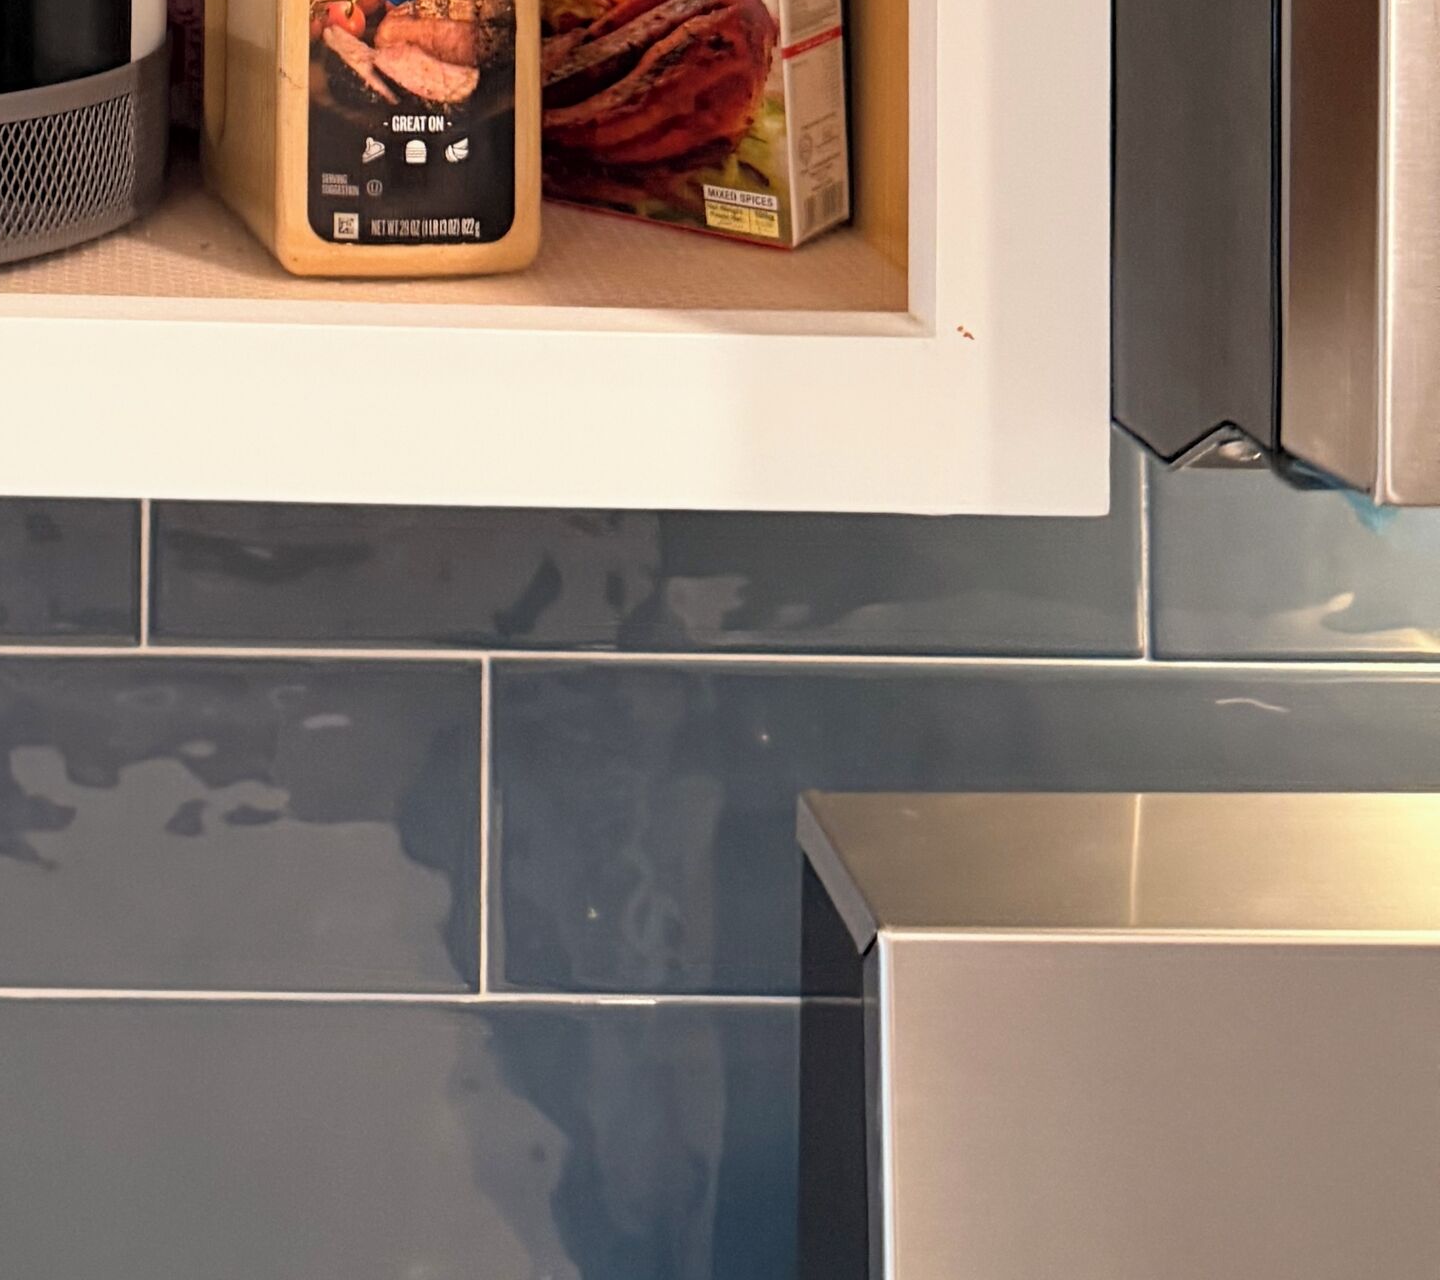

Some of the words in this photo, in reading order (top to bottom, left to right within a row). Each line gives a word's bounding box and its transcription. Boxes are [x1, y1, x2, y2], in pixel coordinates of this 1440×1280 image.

[392, 116, 427, 131] GREAT
[429, 116, 444, 132] ON
[708, 188, 736, 201] MIXED
[740, 193, 773, 207] SPICES
